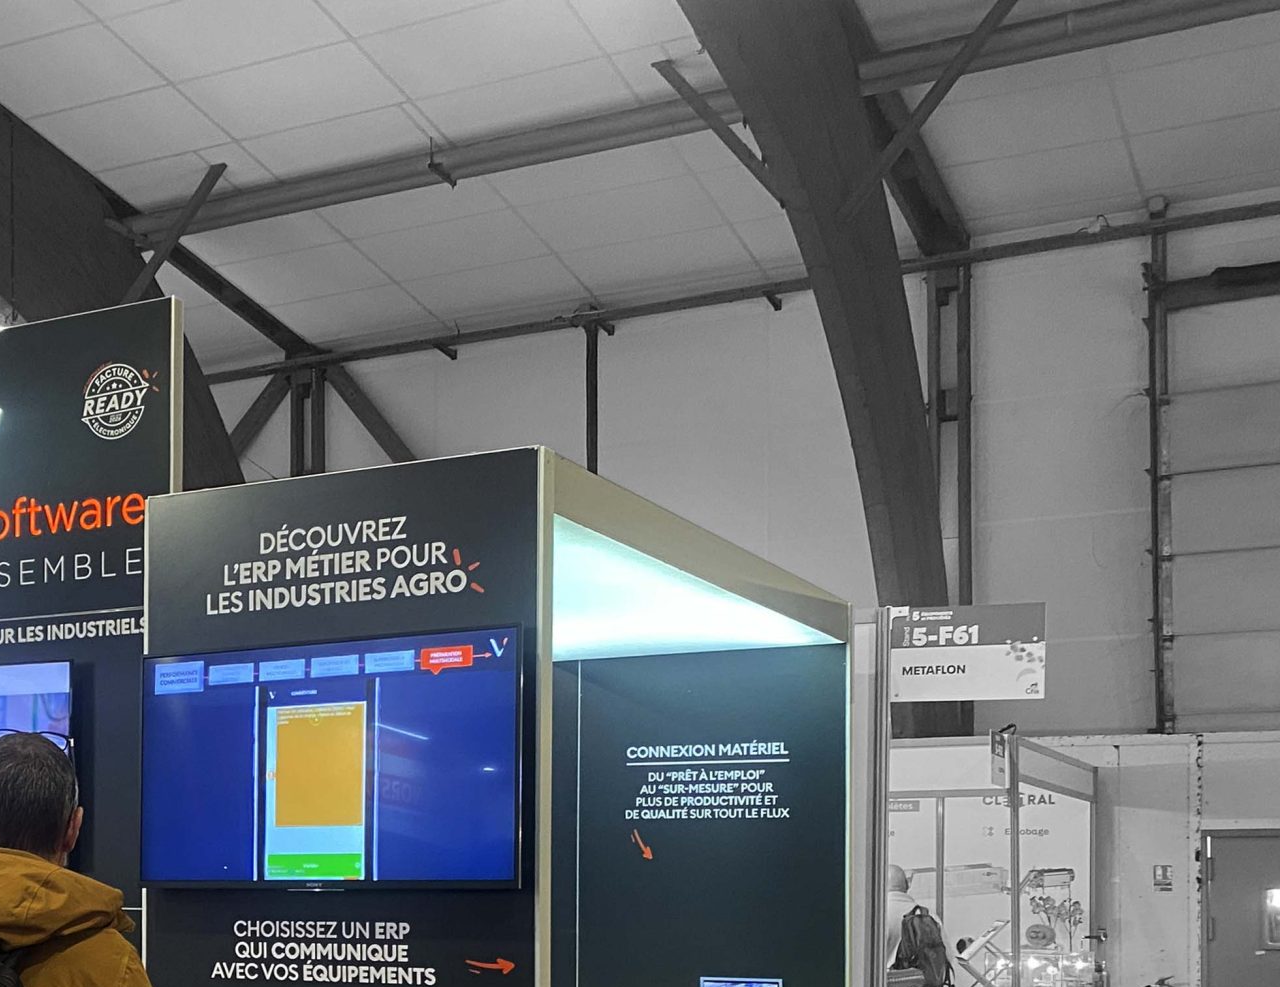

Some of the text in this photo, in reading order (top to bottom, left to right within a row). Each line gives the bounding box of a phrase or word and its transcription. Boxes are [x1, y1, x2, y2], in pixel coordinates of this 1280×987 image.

[94, 367, 135, 387] FACTURE
[83, 388, 148, 417] READY
[259, 516, 407, 555] DÉCOUVREZ
[224, 541, 448, 586] L'ERP MÉTIER POUR
[206, 569, 468, 615] LES INDUSTRIES AGRO
[18, 625, 44, 643] LES
[912, 624, 980, 647] 5-F61
[902, 664, 966, 677] METAFLON
[626, 740, 789, 759] CONNEXION MATÉRIEL
[648, 772, 664, 782] DU
[701, 768, 710, 781] À
[640, 784, 656, 795] AU
[741, 782, 773, 793] POUR
[635, 794, 778, 807] PLUS DE PRODUCTIVITÉ ET
[625, 807, 790, 819] DE QUALITÉ SUR TOUT LE FLUX
[233, 920, 410, 940] CHOISISSEZ UN ERP
[235, 941, 409, 962] QUI COMMUNIQUE
[211, 960, 437, 986] AVEC VOS ÉQUIPEMENTS
